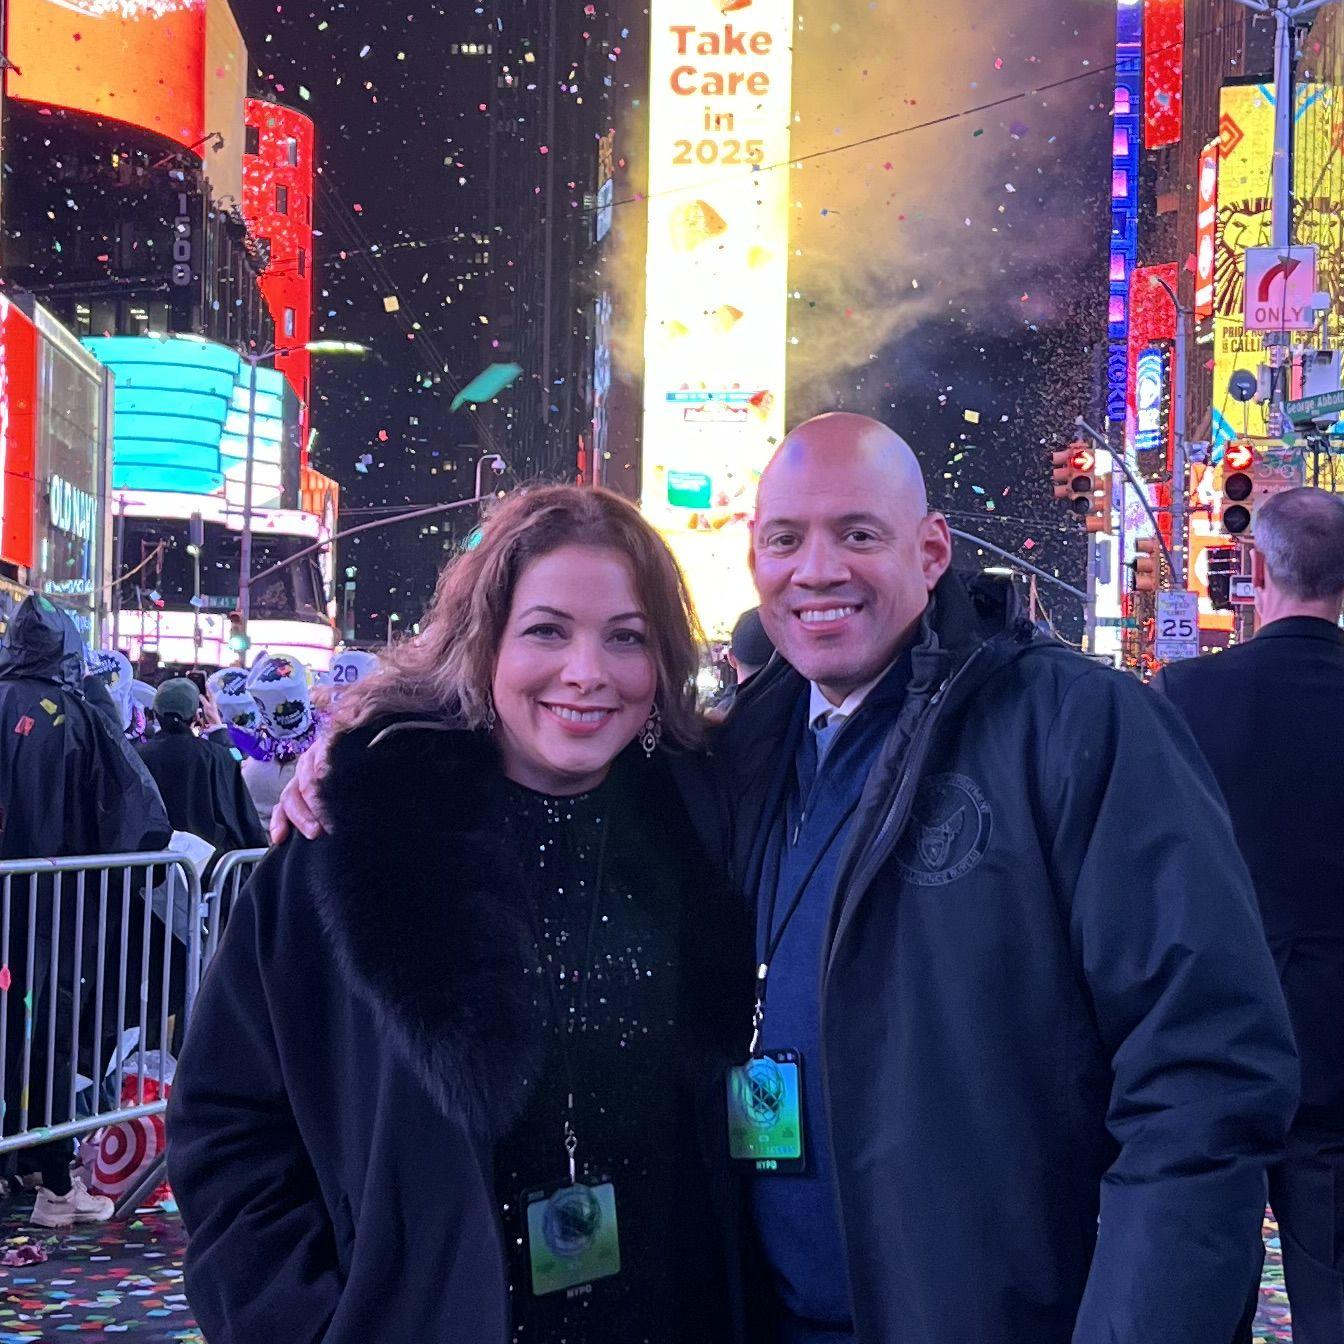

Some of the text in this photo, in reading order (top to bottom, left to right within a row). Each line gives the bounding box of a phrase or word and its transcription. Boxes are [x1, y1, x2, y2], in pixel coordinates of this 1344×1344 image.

[669, 24, 772, 56] Take
[669, 66, 770, 96] Care
[704, 106, 734, 132] in
[672, 139, 765, 165] 2025
[172, 193, 191, 286] 1500
[1255, 307, 1303, 323] ONLY
[1107, 344, 1127, 422] ROKU
[1317, 392, 1344, 408] Abbott
[1162, 619, 1194, 637] 25
[333, 664, 359, 683] 20
